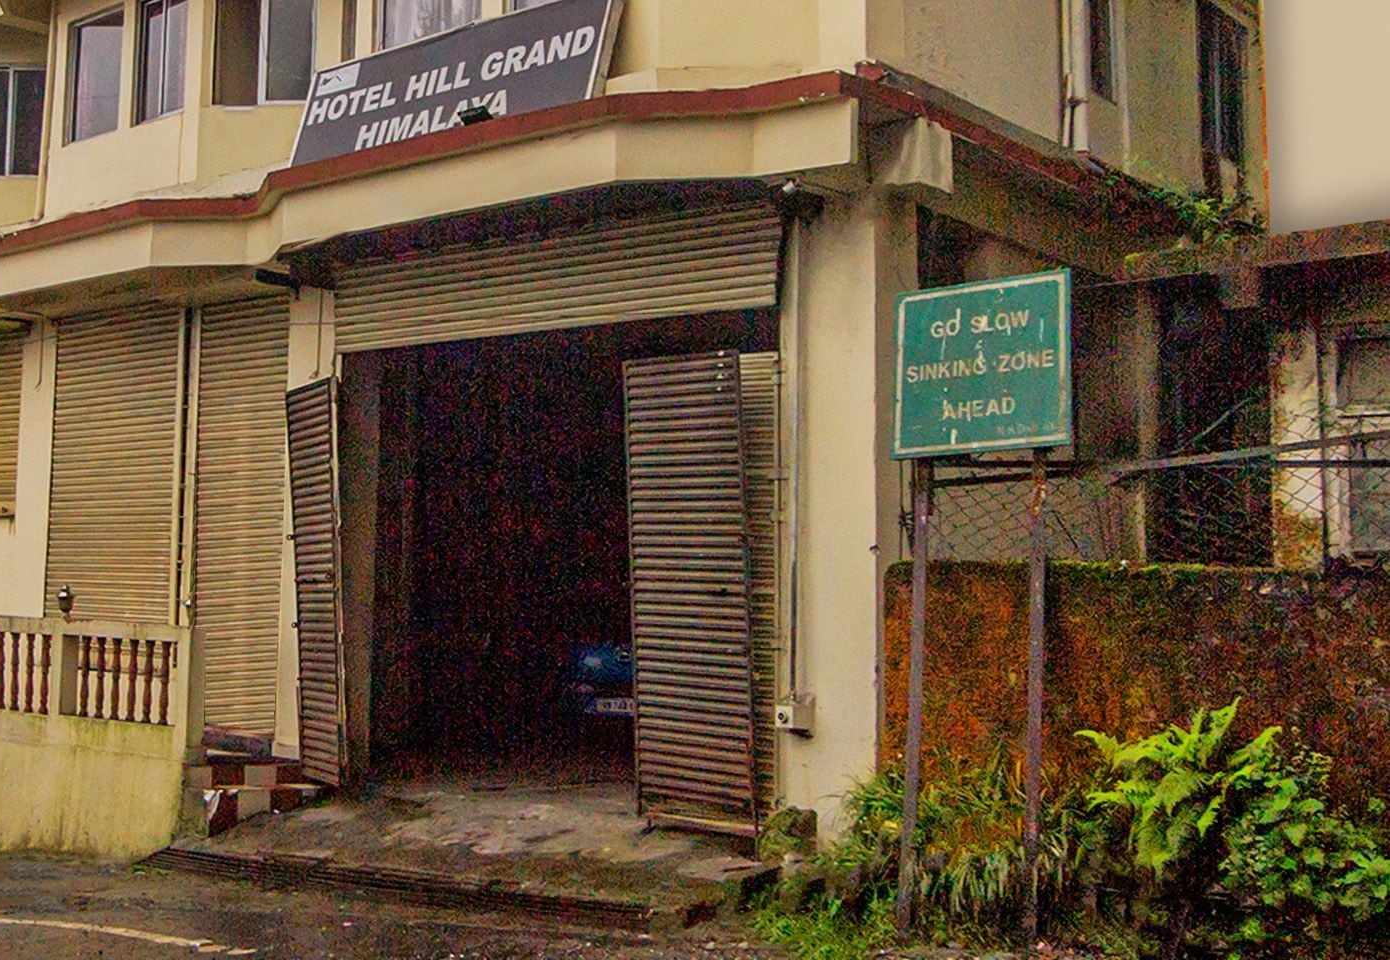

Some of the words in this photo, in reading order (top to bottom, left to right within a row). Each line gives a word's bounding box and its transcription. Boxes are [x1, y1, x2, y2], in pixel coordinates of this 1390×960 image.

[306, 82, 396, 126] HOTEL
[404, 61, 471, 102] HILL
[481, 25, 596, 81] GRAND
[930, 317, 962, 338] GO
[970, 309, 1030, 334] SLOW
[906, 356, 988, 383] SINKING
[997, 348, 1055, 373] ZONE
[942, 396, 1017, 421] AHEAD
